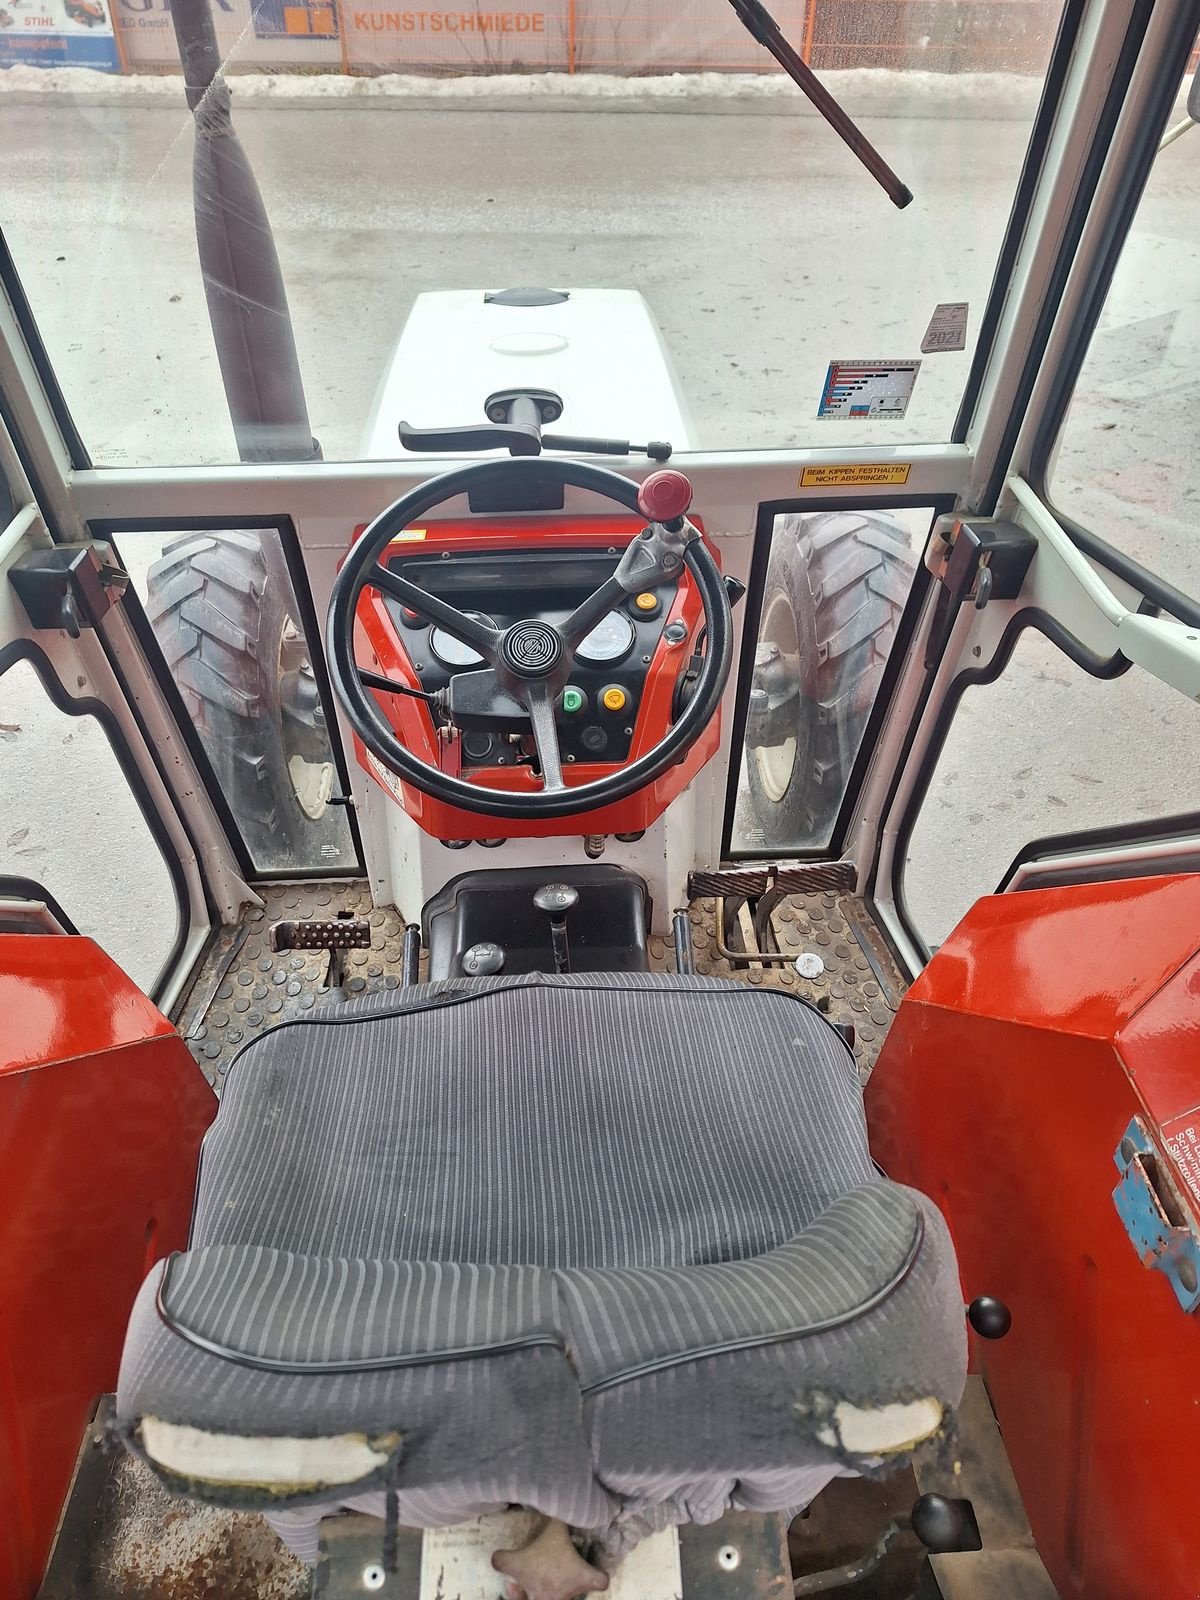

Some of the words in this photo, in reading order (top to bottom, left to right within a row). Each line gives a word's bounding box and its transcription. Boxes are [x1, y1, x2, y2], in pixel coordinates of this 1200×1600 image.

[24, 16, 56, 26] STIHL
[138, 18, 169, 28] GmbH
[354, 11, 545, 33] KUNSTSCHMIEDE
[840, 474, 889, 482] ABSPRINGEN
[1185, 1127, 1197, 1144] Bei
